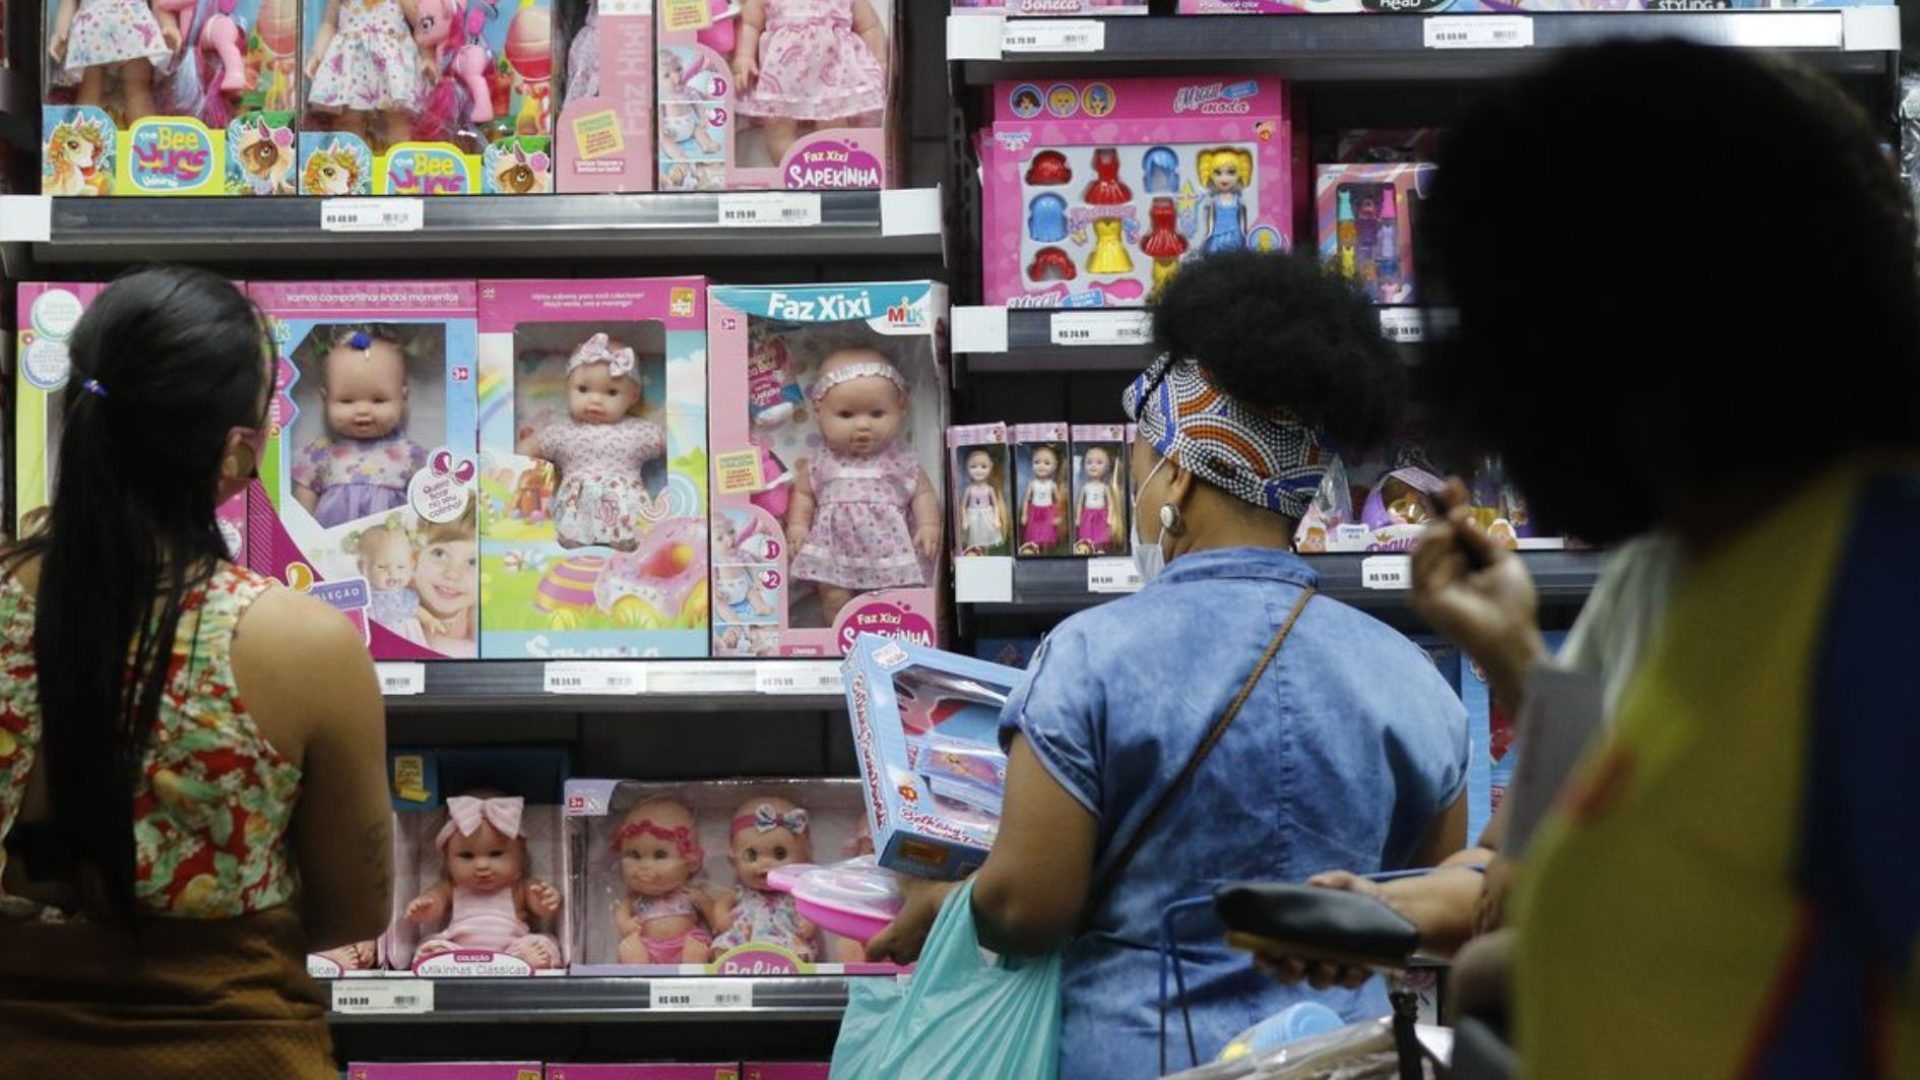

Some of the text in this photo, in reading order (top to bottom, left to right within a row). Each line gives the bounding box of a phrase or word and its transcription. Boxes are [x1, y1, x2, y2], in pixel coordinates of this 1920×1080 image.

[158, 126, 199, 151] Bee
[413, 153, 455, 176] Bee
[803, 150, 849, 164] Faz Xixi
[767, 289, 872, 321] Faz Xixi
[857, 611, 902, 626] Faz Xixi
[420, 963, 472, 976] Milkinhas
